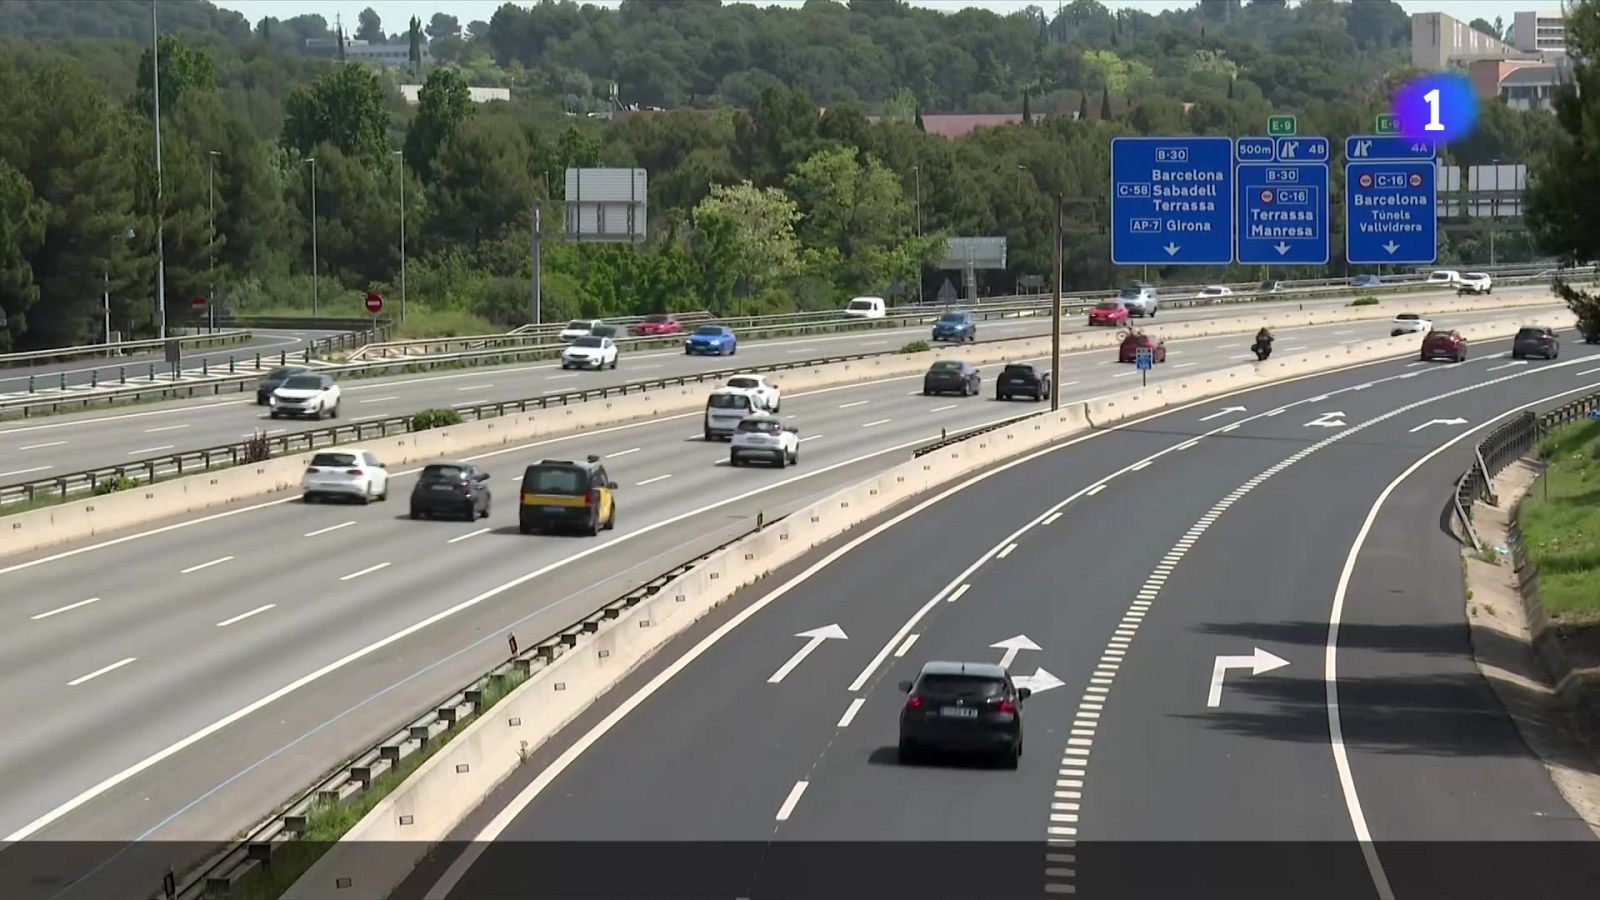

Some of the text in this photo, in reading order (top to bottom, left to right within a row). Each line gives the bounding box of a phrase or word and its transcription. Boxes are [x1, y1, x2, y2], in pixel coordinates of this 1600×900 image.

[1240, 145, 1271, 154] 500m
[1309, 145, 1324, 153] 4B
[1159, 151, 1185, 159] B-30
[1153, 170, 1223, 181] Barcelona
[1269, 171, 1295, 180] B-30
[1378, 175, 1403, 185] C-16
[1120, 186, 1148, 194] C-58
[1153, 185, 1216, 196] Sabadell
[1280, 192, 1305, 201] C-16
[1355, 195, 1427, 205] Barcelona
[1153, 200, 1214, 211] Terrassa
[1251, 209, 1313, 220] Terrassa
[1372, 210, 1410, 220] Túnels
[1133, 222, 1159, 230] AP-7
[1167, 220, 1211, 231] Girona
[1360, 223, 1422, 232] Vallvidrera
[1252, 226, 1312, 237] Manresa
